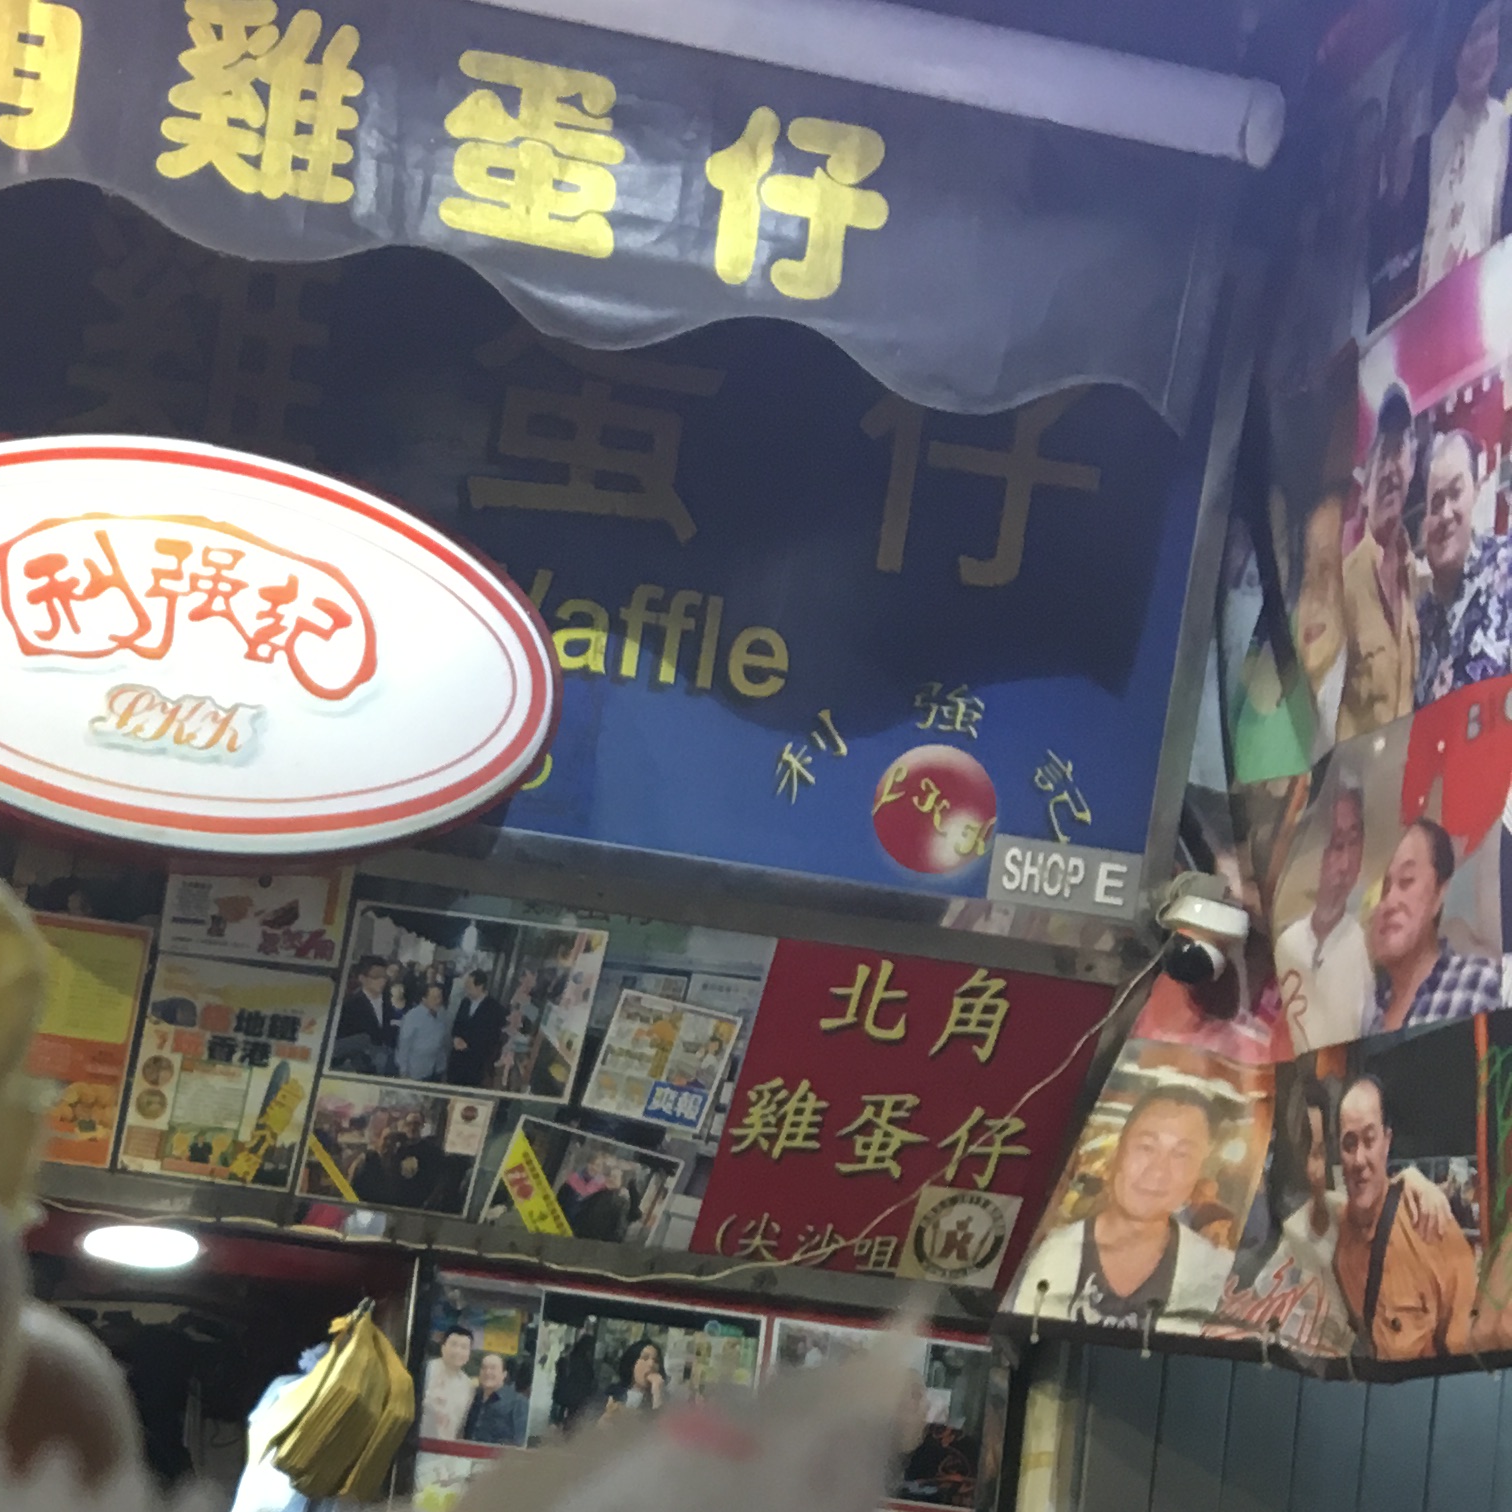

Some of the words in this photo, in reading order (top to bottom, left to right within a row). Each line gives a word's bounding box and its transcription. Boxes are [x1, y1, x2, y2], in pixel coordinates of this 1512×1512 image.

[529, 568, 790, 698] affle
[1002, 846, 1085, 898] SHOP
[1094, 861, 1128, 907] E
[819, 958, 1011, 1063] 北角
[729, 1076, 1031, 1190] 雞蛋仔
